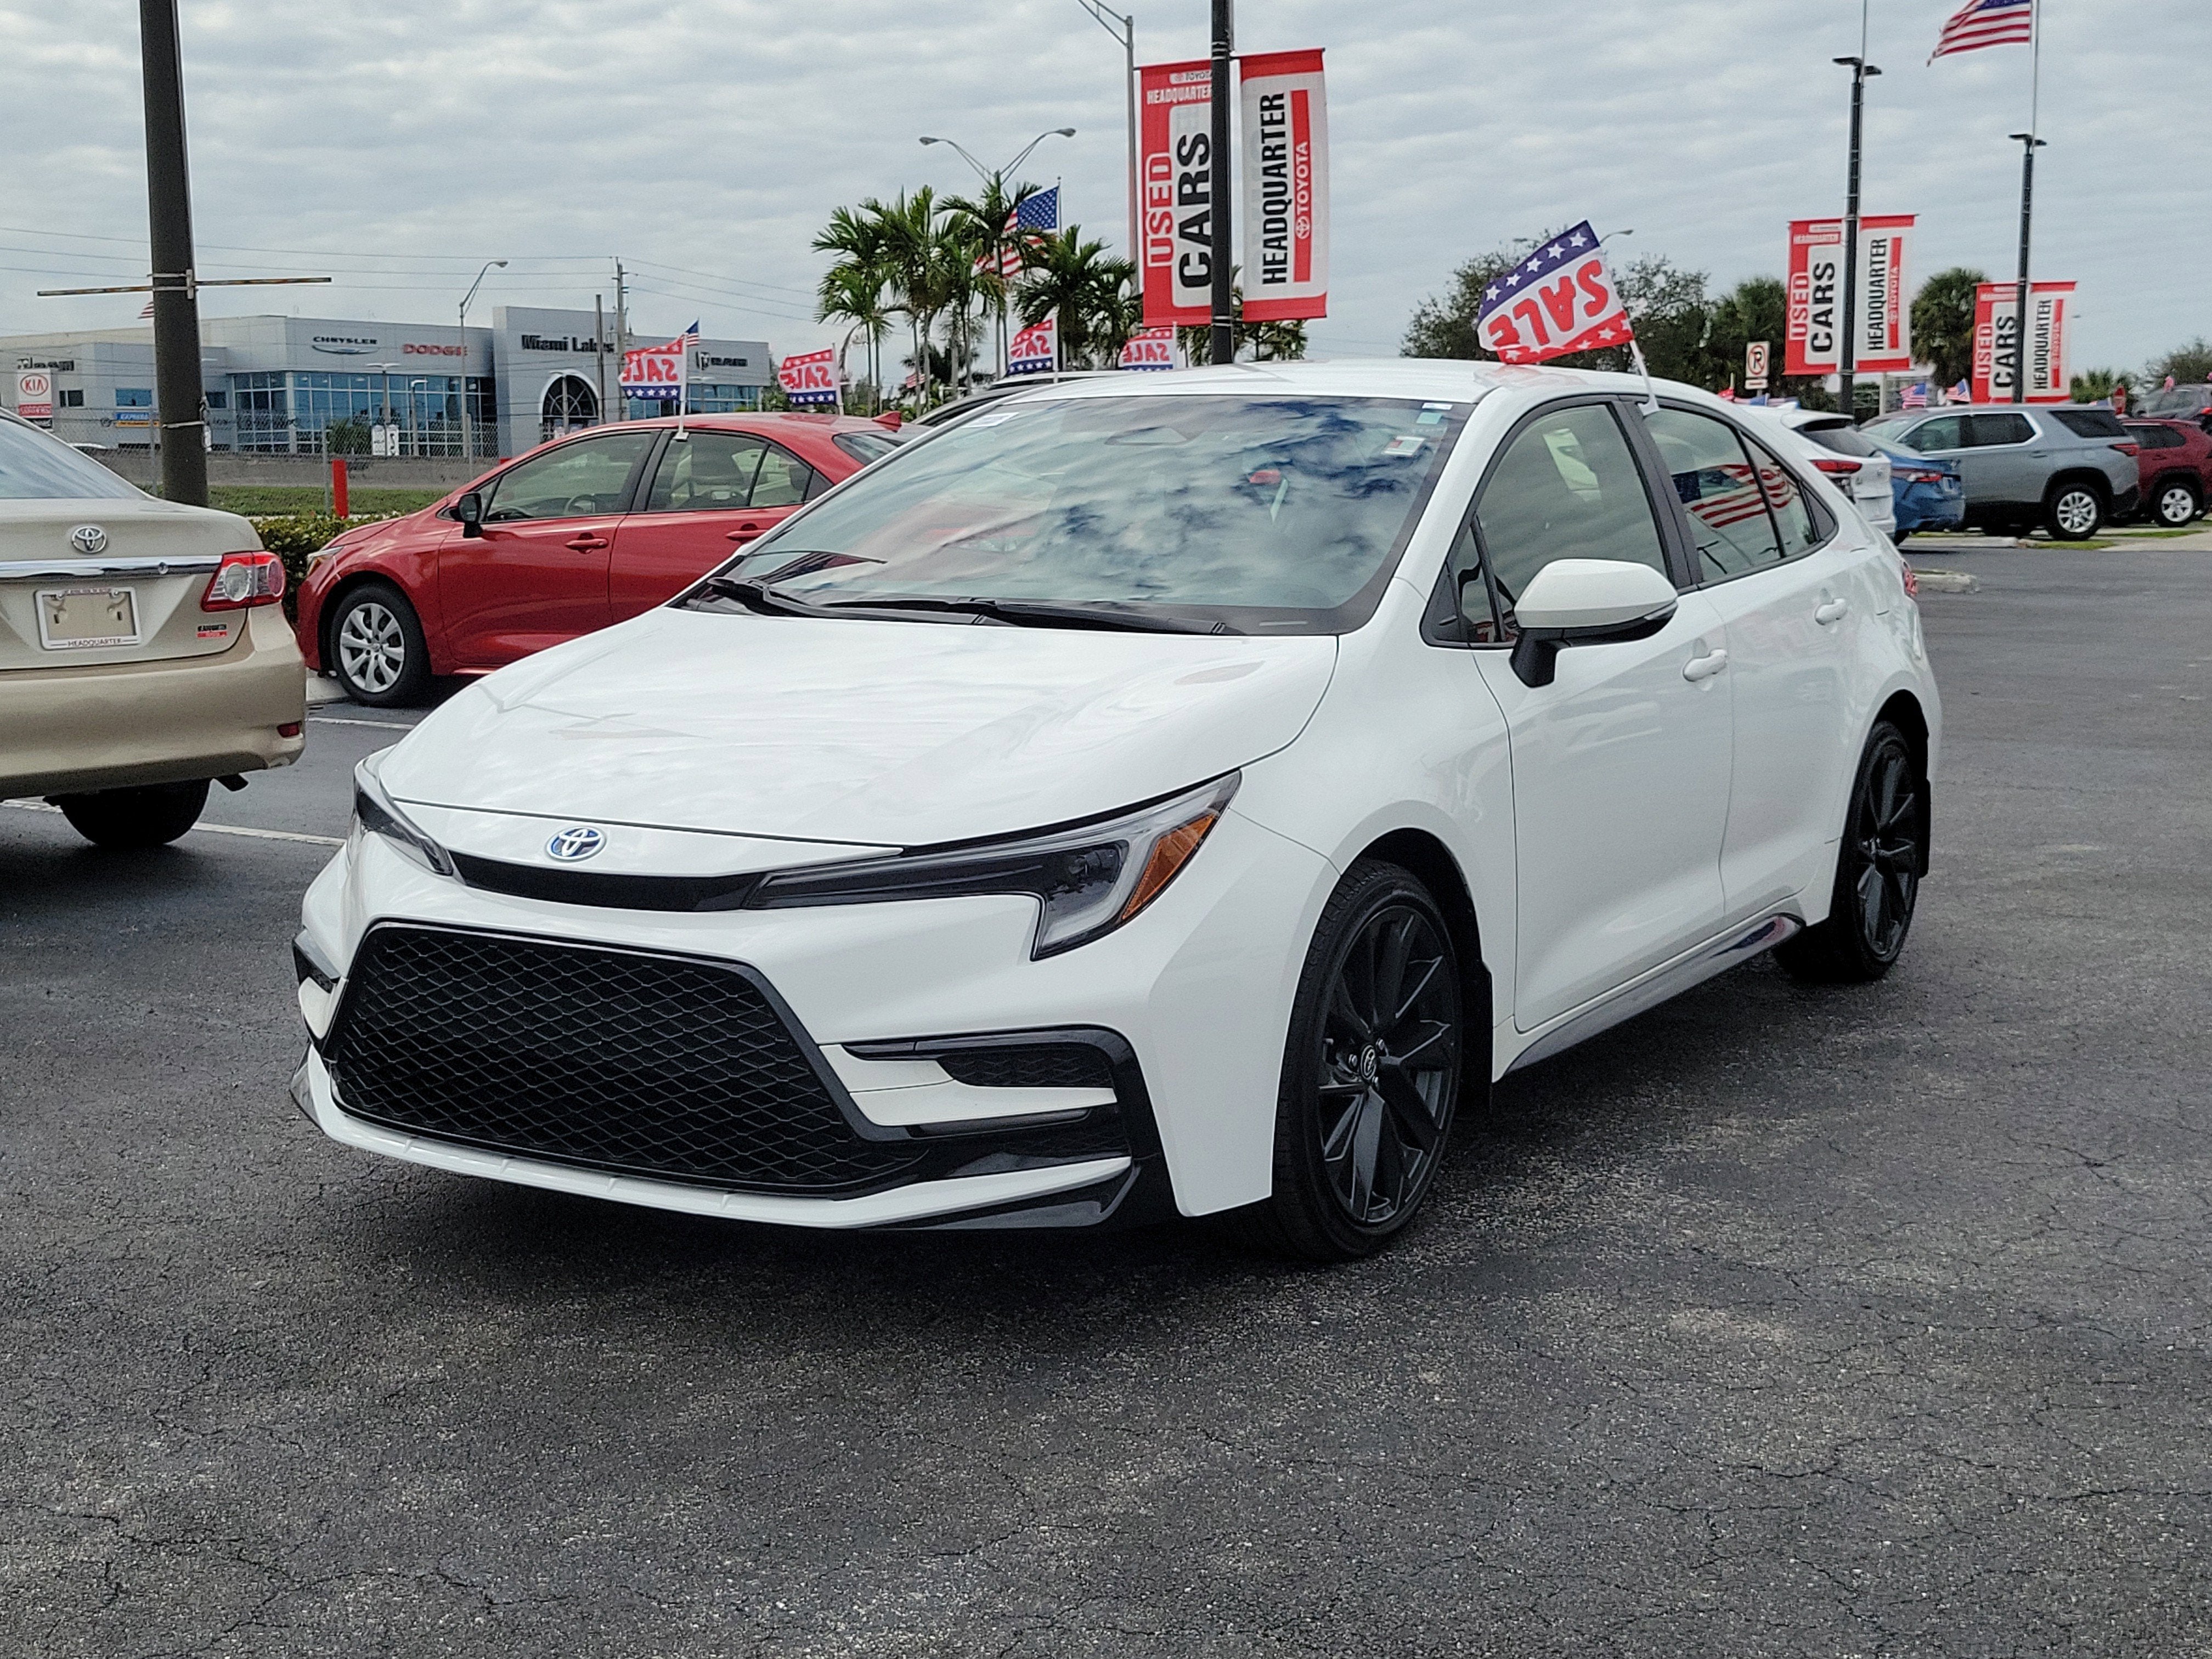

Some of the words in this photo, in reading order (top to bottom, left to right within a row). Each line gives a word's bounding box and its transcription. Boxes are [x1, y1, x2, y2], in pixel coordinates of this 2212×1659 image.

[1147, 85, 1212, 104] HEADQUARTE
[1186, 71, 1211, 81] TOYOT
[1147, 152, 1173, 268] USED
[1177, 132, 1211, 289] CARS
[1260, 92, 1292, 285] HEADQUARTER
[1295, 142, 1310, 214] TOYOTA
[1488, 259, 1609, 346] SALE
[1789, 272, 1809, 341] USED
[1811, 262, 1835, 352] CARS
[1868, 238, 1887, 351] HEADQUARTER
[313, 336, 377, 345] CHRYSLER
[522, 335, 568, 351] Miami
[1976, 323, 1993, 379] USED
[1994, 316, 2016, 387] CARS
[2034, 300, 2052, 390] HEADQUARTER
[25, 379, 44, 391] KIA
